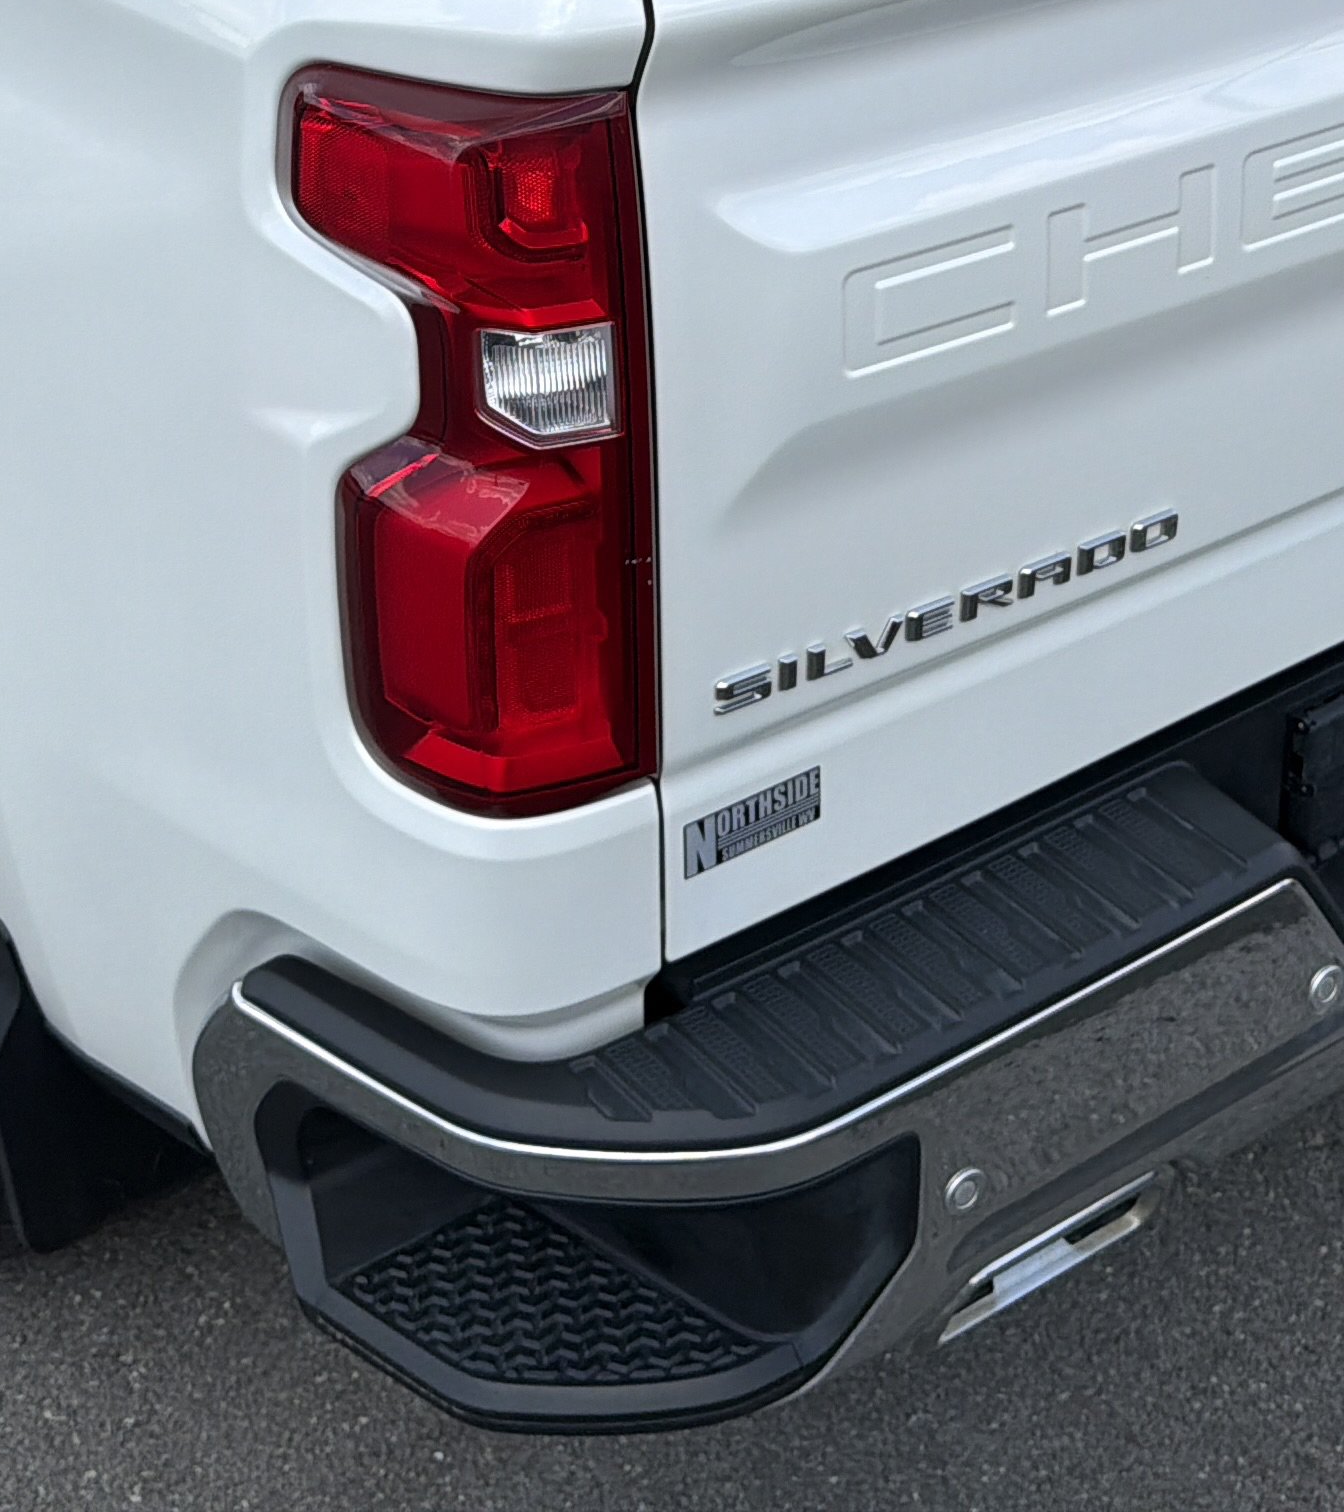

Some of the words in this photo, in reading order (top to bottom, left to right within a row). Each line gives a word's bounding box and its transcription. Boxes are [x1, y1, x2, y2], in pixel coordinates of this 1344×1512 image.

[713, 507, 1180, 715] SILVERADO
[686, 769, 819, 877] NORTHSIDE
[721, 814, 797, 861] SUMMERSVILLE
[798, 807, 816, 826] WV
